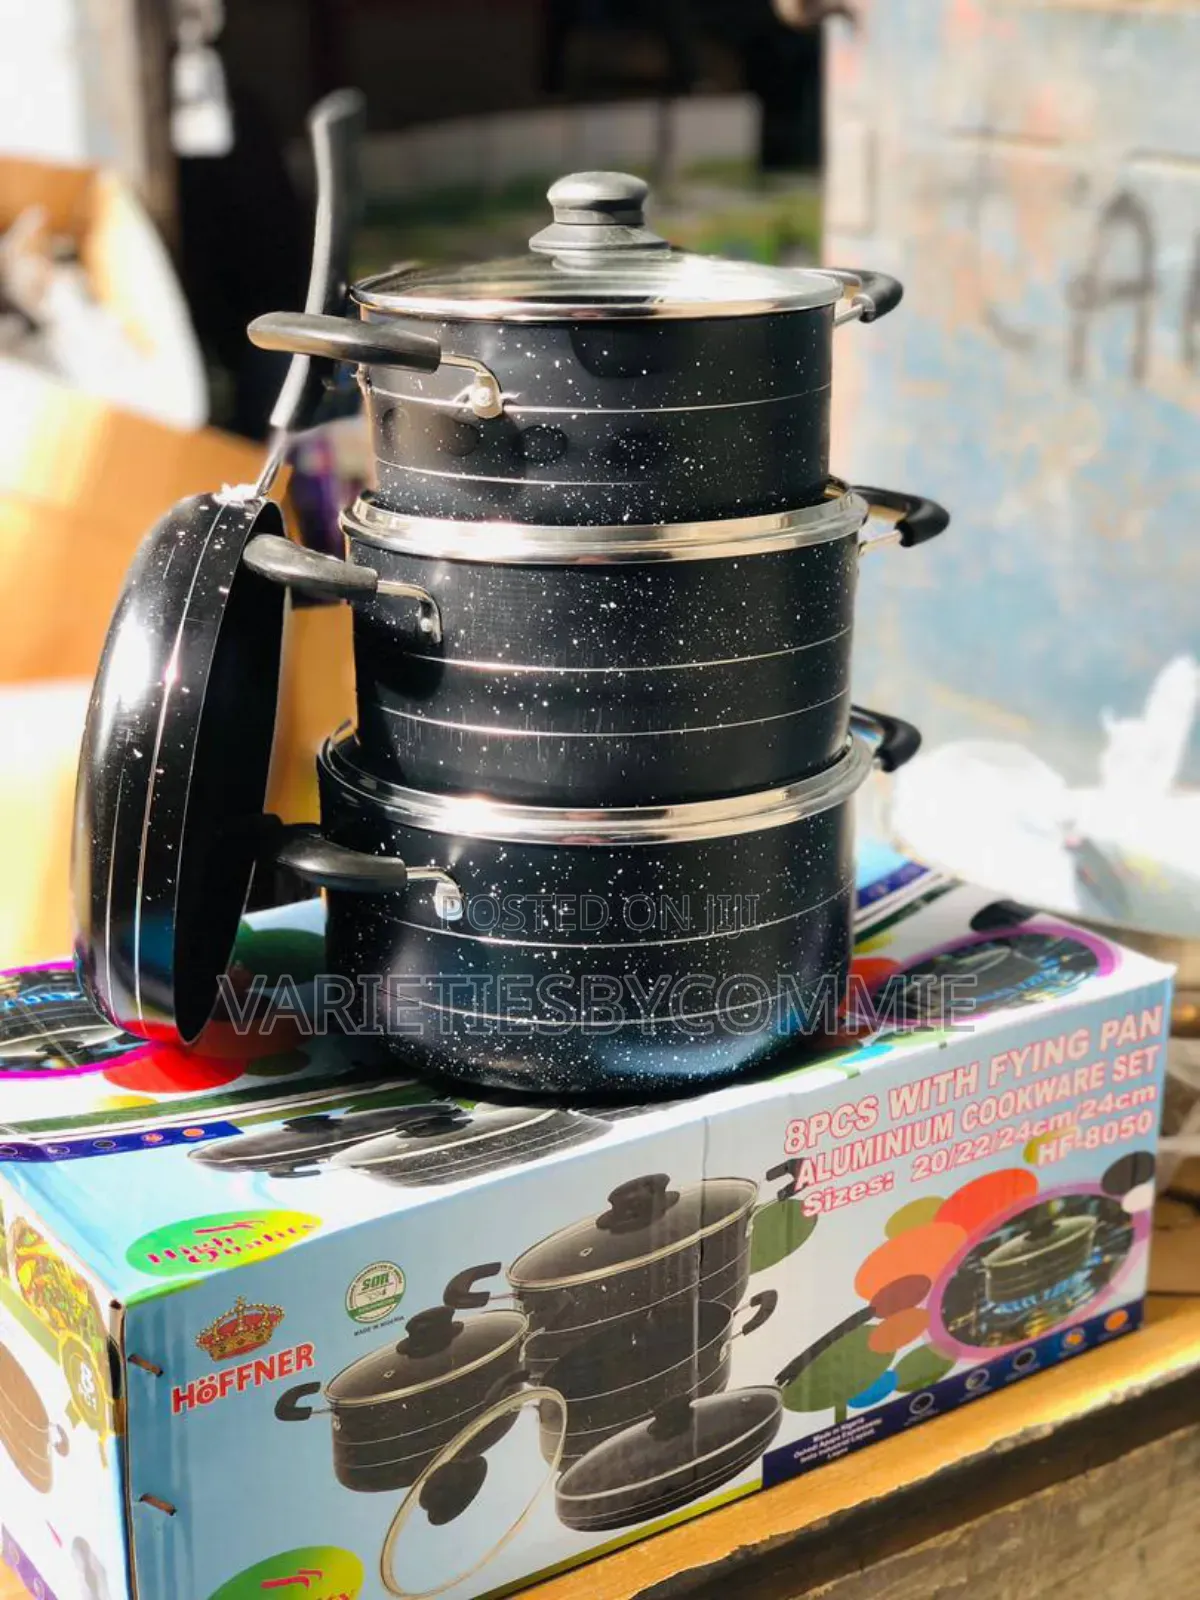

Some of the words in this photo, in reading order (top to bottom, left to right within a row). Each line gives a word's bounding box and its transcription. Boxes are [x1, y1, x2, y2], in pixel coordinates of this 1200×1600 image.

[784, 1095, 880, 1155] 8PCS
[888, 1061, 980, 1120] WITH
[988, 1027, 1090, 1087] FYING
[1100, 1006, 1163, 1050] PAN
[794, 1112, 955, 1191] ALUMINIUM
[961, 1063, 1105, 1133] COOKWARE
[1112, 1045, 1161, 1083] SET
[1036, 1110, 1153, 1169] HF-8050
[802, 1172, 895, 1217] Sizes:
